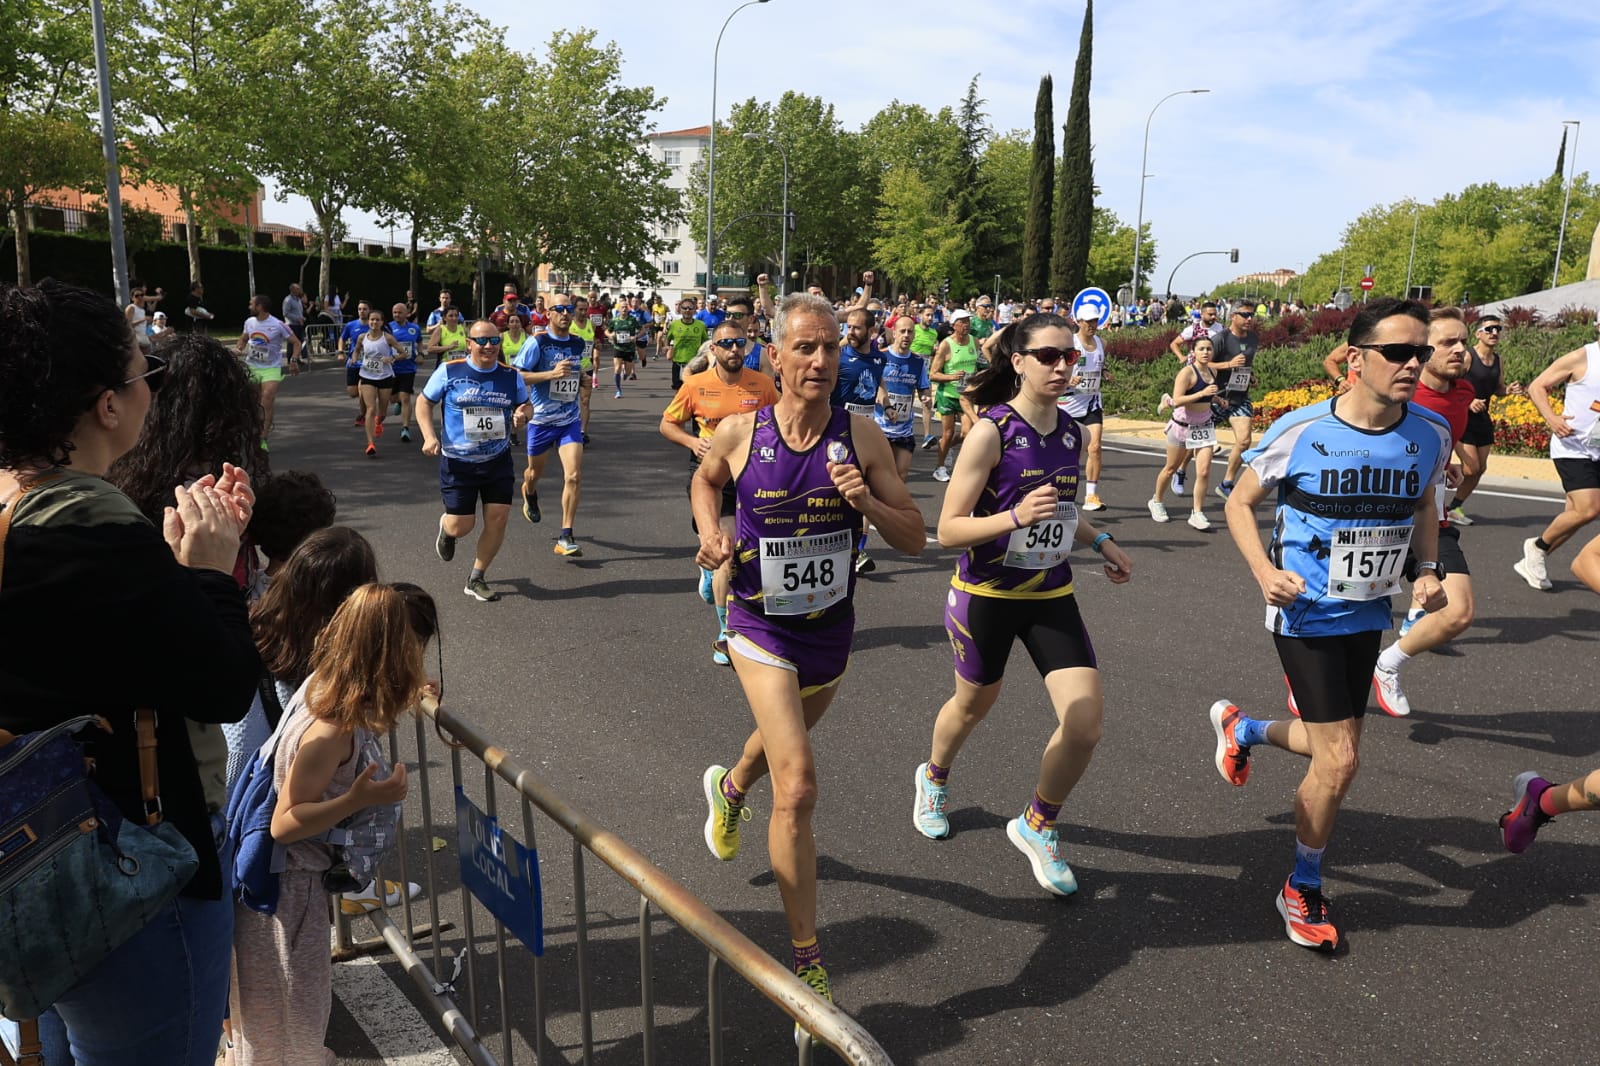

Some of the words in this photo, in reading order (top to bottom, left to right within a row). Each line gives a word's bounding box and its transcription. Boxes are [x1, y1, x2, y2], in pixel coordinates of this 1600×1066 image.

[555, 380, 578, 393] 1212
[477, 417, 493, 431] 46
[1191, 430, 1210, 440] 633
[1330, 448, 1370, 459] running
[1320, 464, 1420, 497] naturé
[754, 488, 788, 498] Jamón
[807, 497, 841, 507] PRIM
[1310, 502, 1351, 513] centro
[1355, 501, 1373, 513] de
[1026, 523, 1063, 549] 549
[766, 541, 785, 557] XII
[1342, 548, 1402, 578] 1577
[783, 558, 835, 592] 548
[471, 842, 516, 902] LOCAL
